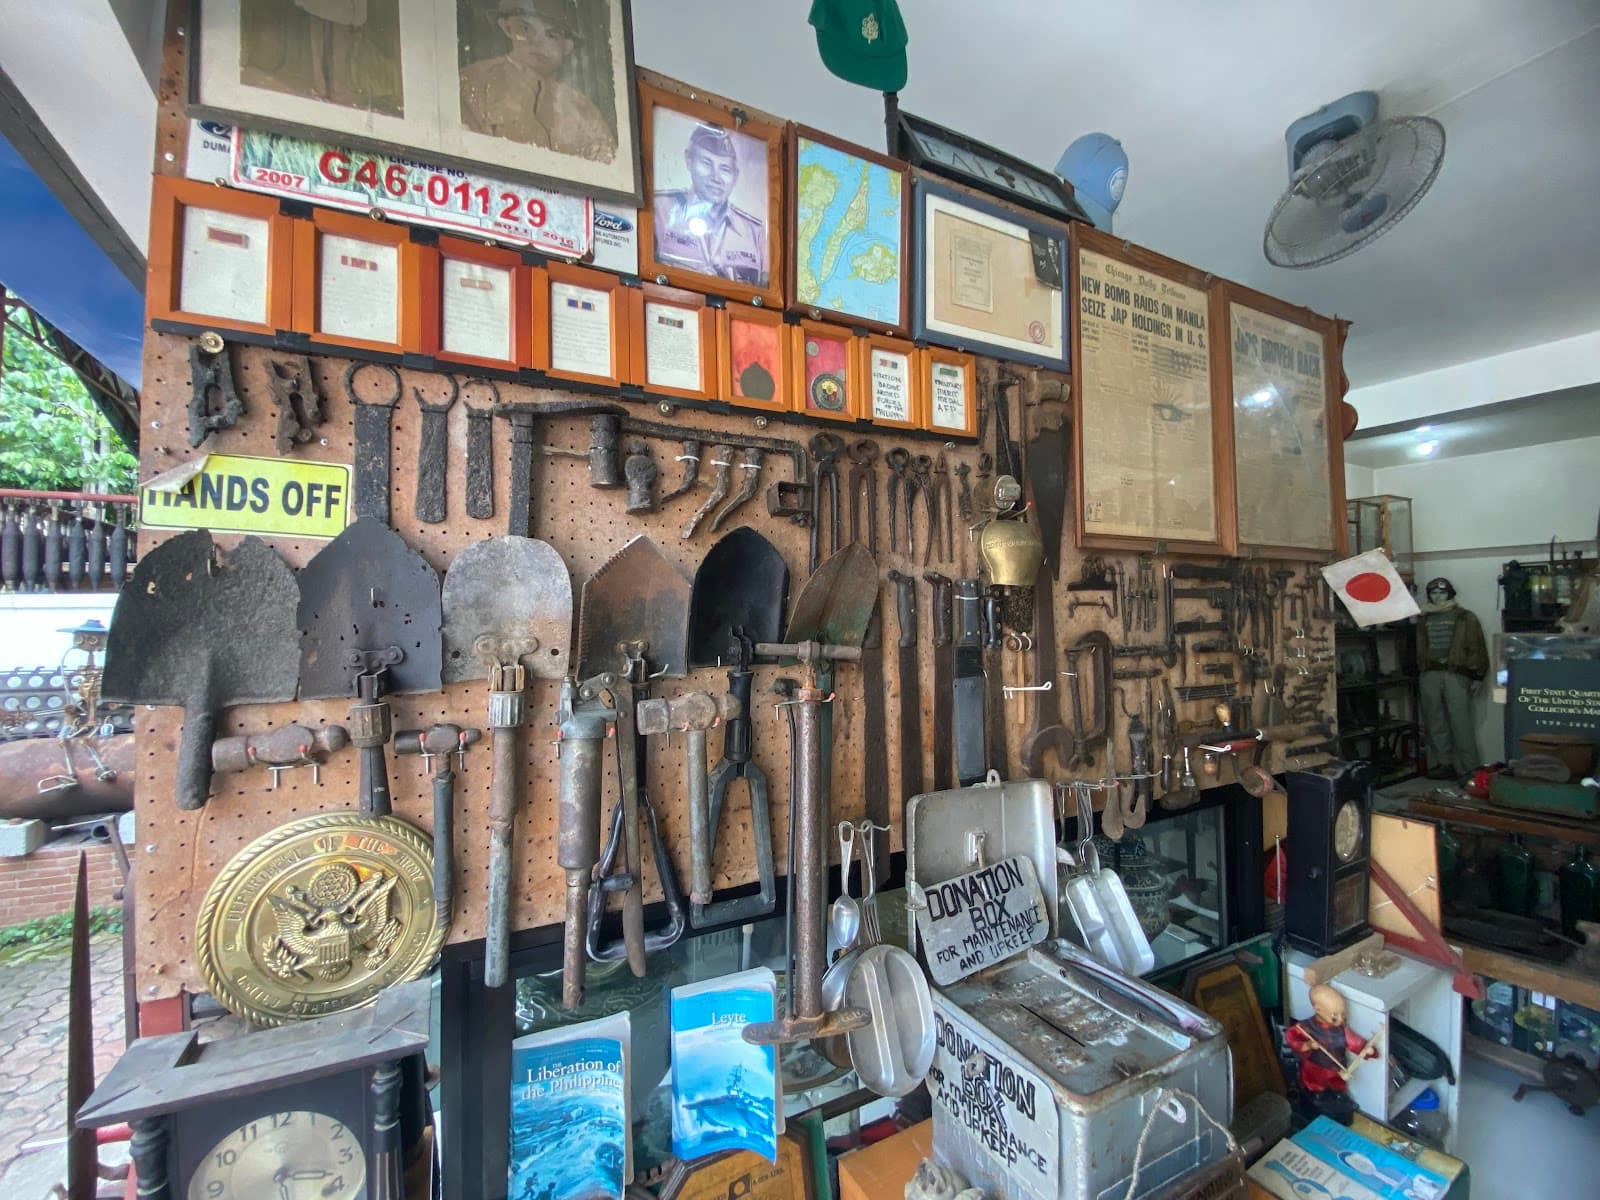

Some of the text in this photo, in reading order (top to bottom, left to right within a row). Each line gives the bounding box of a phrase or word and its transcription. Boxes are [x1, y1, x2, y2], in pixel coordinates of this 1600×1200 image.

[256, 169, 305, 188] 2007
[389, 156, 468, 179] LICENSE NO.
[319, 150, 547, 228] G46-01129
[1081, 275, 1206, 330] NEW BOMB RAIDS ON MANILA
[1081, 297, 1106, 319] SEIZE
[1111, 306, 1128, 325] JAP
[1131, 312, 1171, 339] HOLDINGS
[281, 480, 342, 518] OFF
[924, 858, 1024, 922] DONATION
[969, 896, 1012, 932] BOX
[936, 905, 1043, 965] FOR MAINTENANCE
[959, 951, 985, 971] AND
[711, 1011, 747, 1027] Leyte
[527, 1057, 622, 1083] Liberation of
[934, 1011, 1036, 1121] DONTION
[521, 1085, 545, 1101] the
[270, 1111, 292, 1129] 12
[329, 1122, 345, 1141] 2
[239, 1123, 258, 1142] 11
[963, 1111, 1018, 1168] UPKEEP
[215, 1149, 237, 1168] 10
[338, 1147, 354, 1165] 3
[206, 1180, 225, 1199] 9
